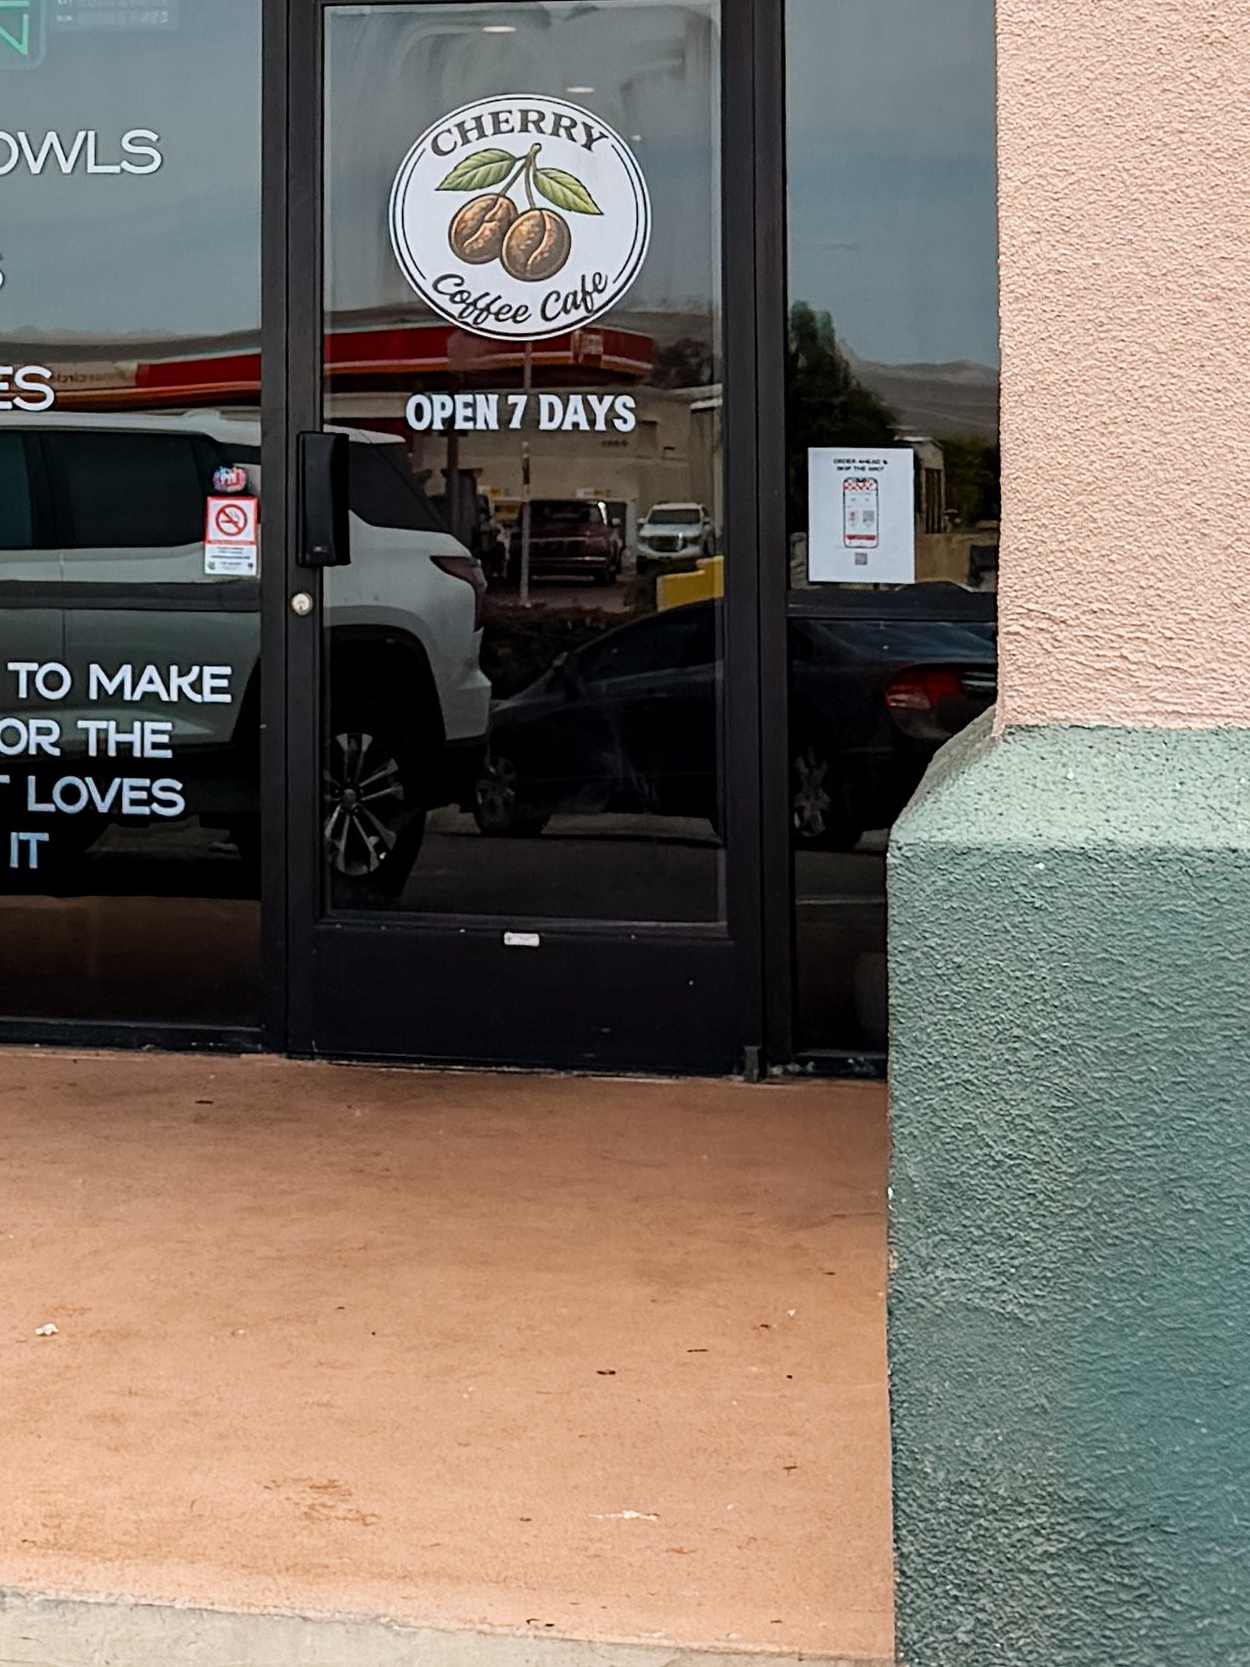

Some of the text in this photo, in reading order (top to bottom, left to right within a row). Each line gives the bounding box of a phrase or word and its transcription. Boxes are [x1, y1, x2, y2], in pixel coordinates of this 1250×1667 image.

[430, 109, 608, 157] CHERRY
[432, 271, 609, 326] Coffee Cafe
[405, 394, 637, 432] OPEN 7 DAYS
[7, 661, 73, 701] TO
[88, 662, 233, 704] MAKE
[76, 719, 174, 759] THE
[27, 775, 186, 817] LOVES
[10, 831, 50, 869] IT
